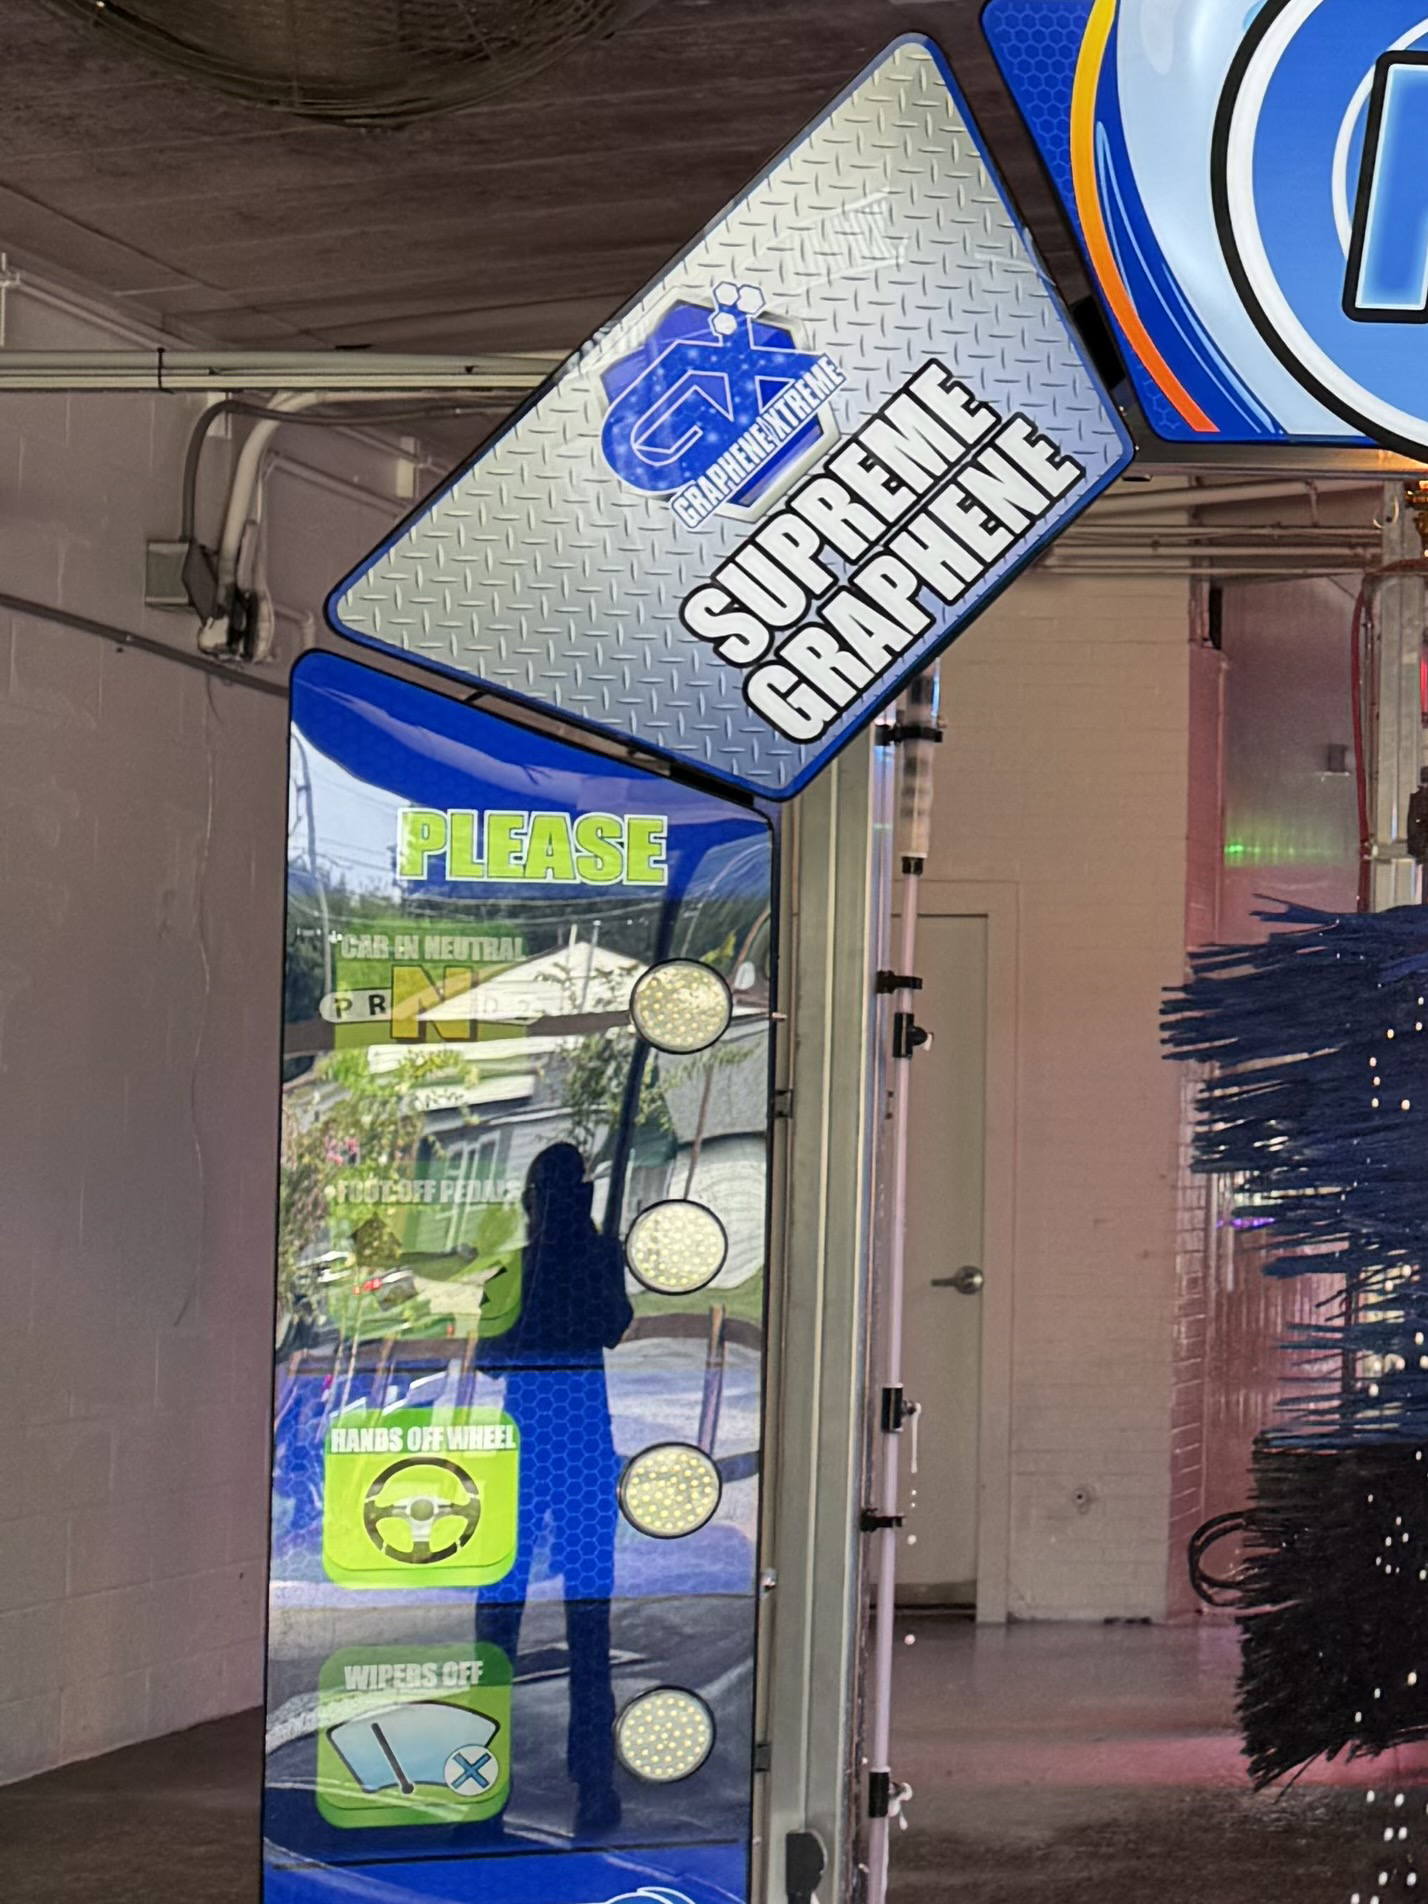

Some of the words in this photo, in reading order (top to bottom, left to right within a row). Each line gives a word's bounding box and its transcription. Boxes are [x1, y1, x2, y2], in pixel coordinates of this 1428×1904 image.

[671, 426, 774, 528] GRAPHENE
[766, 355, 845, 444] XTREME
[681, 360, 997, 666] SUPREME
[744, 413, 1084, 742] GRAPHENE
[397, 808, 668, 885] PLEASE
[341, 934, 389, 959] CAR
[395, 935, 419, 959] IN
[425, 935, 527, 961] NEUTRAL
[368, 994, 386, 1016] R
[330, 1427, 403, 1453] HANDS
[407, 1426, 443, 1452] OFF
[448, 1425, 517, 1451] WHEEL
[344, 1662, 436, 1691] WIPERS
[442, 1660, 484, 1687] OFF
